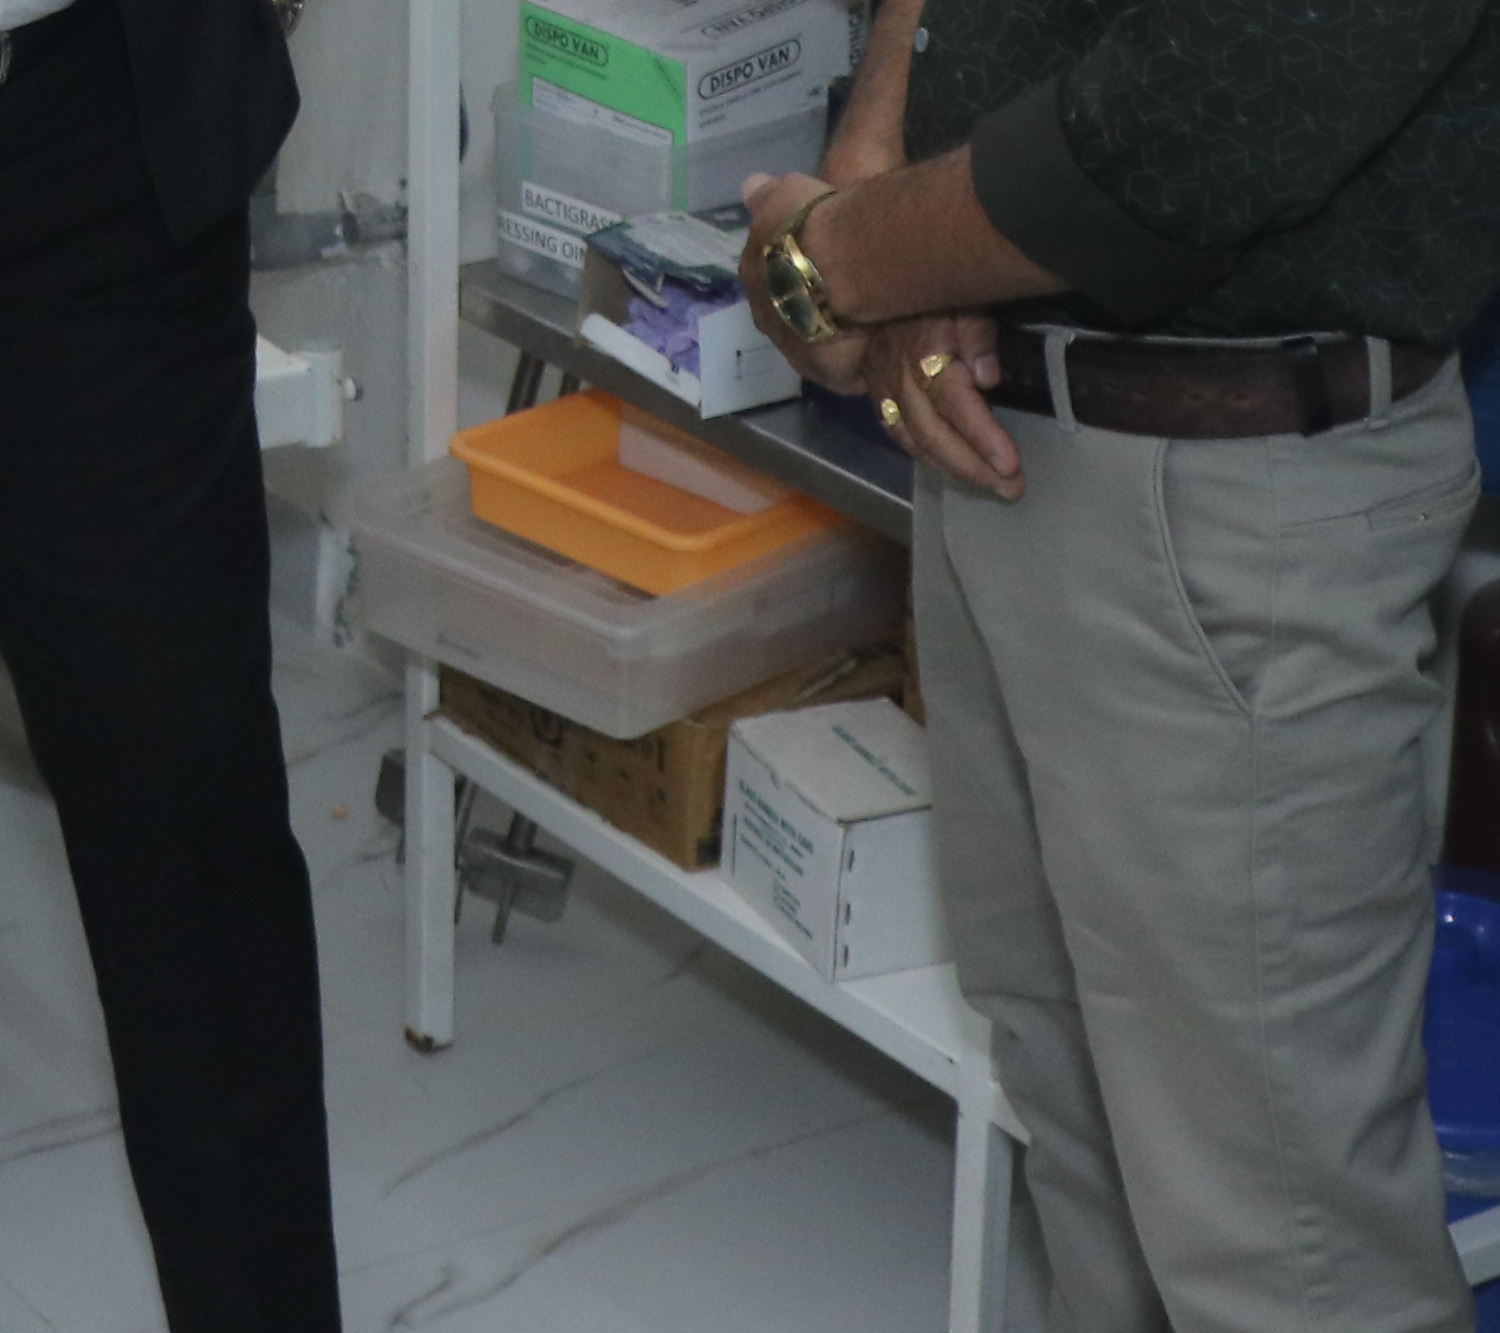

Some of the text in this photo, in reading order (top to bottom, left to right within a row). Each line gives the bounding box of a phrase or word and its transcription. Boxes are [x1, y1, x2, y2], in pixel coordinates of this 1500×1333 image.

[533, 21, 600, 60] DISPO VAN
[709, 46, 790, 94] DISPO VAN
[524, 189, 615, 232] BACTIGRAS
